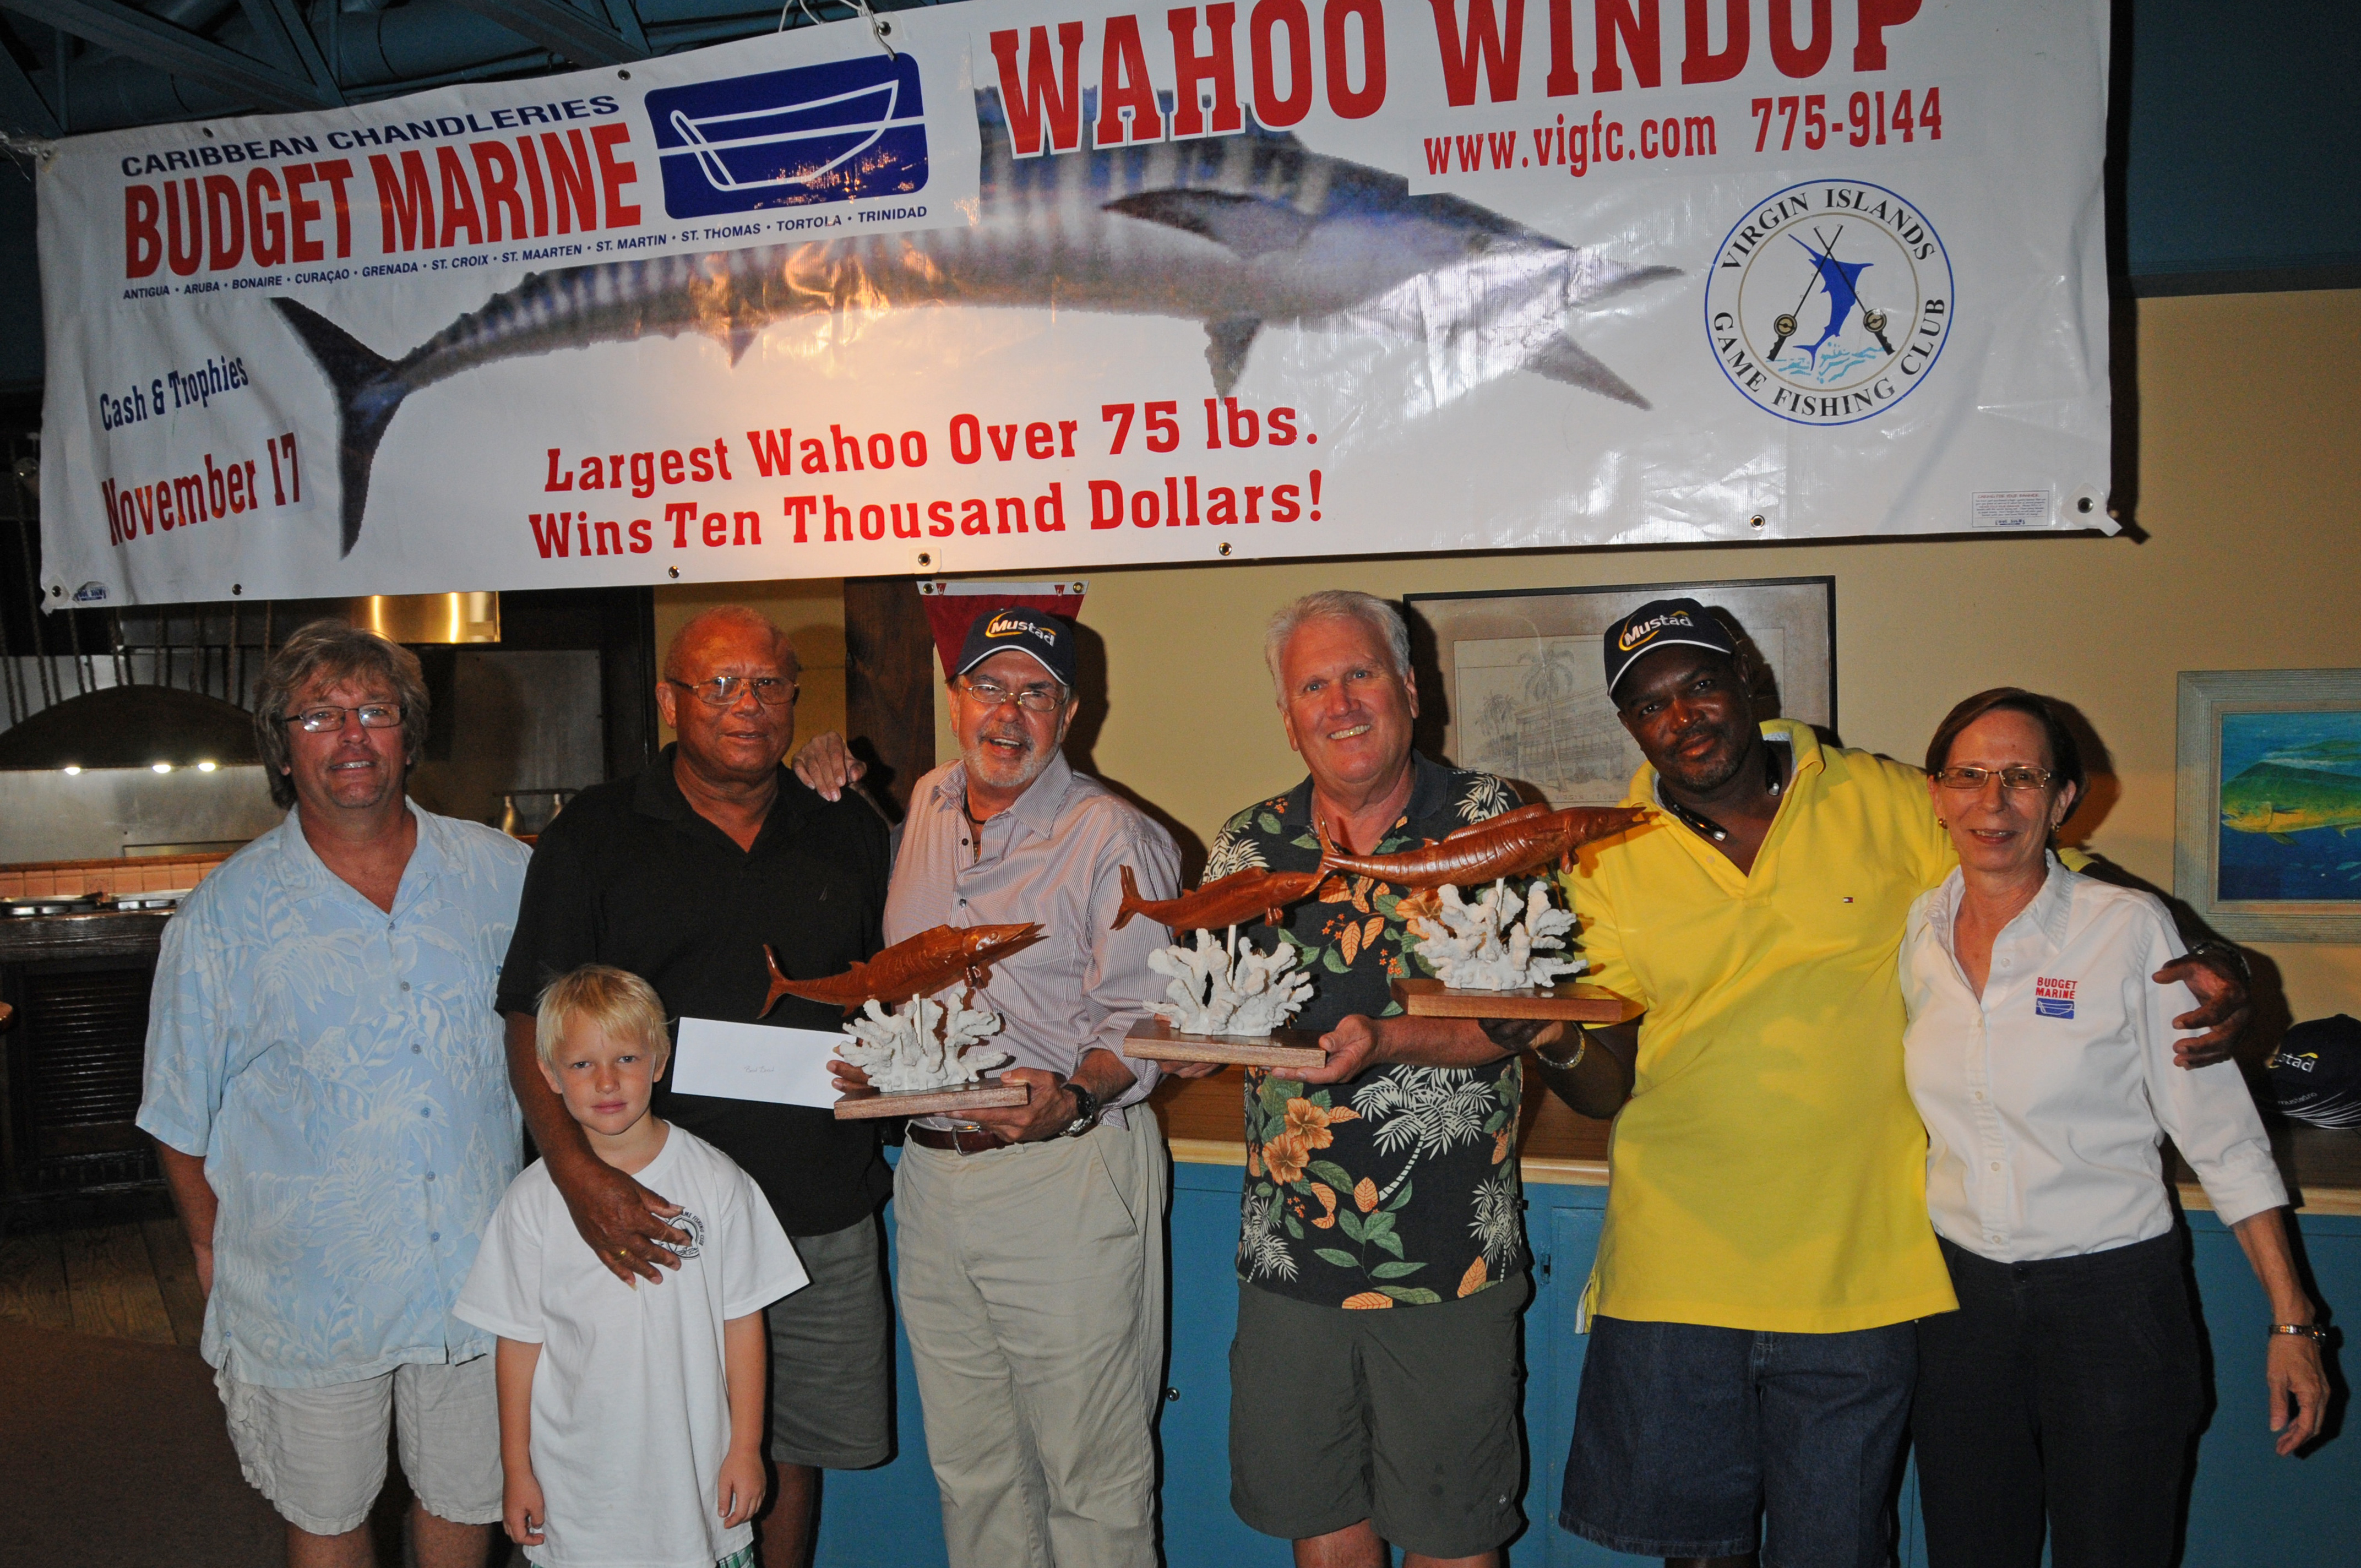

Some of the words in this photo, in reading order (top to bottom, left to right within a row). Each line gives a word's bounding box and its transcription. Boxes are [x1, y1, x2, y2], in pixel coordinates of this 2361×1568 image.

[989, 0, 1386, 154] WAHOO
[1429, 0, 1922, 107] WINDUP
[122, 137, 318, 176] CARIBBEAN
[328, 96, 619, 149] CHANDLERIES
[1424, 110, 1717, 177] www.vigfc.com
[1752, 88, 1941, 151] 775-9144
[127, 159, 352, 277] BUDGET
[369, 123, 641, 253] MARINE
[1721, 192, 1809, 269] VIRGIN
[1825, 188, 1936, 260] ISLANDS
[123, 286, 170, 299] ANTIGUA
[184, 282, 219, 294] ARUBA
[232, 276, 281, 289] BONAIRE
[296, 269, 349, 284] CURAÇAO
[362, 263, 418, 276] GRENADA
[432, 259, 446, 270] ST.
[452, 255, 488, 268] CROIX
[502, 252, 516, 262] ST.
[523, 245, 581, 260] MAARTEN
[597, 241, 611, 252] ST.
[618, 235, 666, 249] MARTIN
[682, 231, 697, 241] ST.
[704, 224, 760, 238] THOMAS
[777, 215, 841, 231] TORTOLA
[858, 207, 927, 222] TRINIDAD
[100, 386, 148, 431] Cash
[152, 379, 165, 415] &
[168, 356, 248, 408] Trophies
[1714, 312, 1767, 392] GAME
[1771, 377, 1895, 417] FISHING
[1901, 299, 1945, 375] CLUB
[101, 453, 258, 546] November
[266, 432, 301, 507] 17
[545, 437, 732, 499] Largest
[746, 423, 928, 478] Wahoo
[949, 413, 1078, 465] Over
[1101, 401, 1180, 455] 75
[1204, 397, 1318, 449] lbs.
[529, 511, 653, 558] Wins
[665, 502, 762, 548] Ten
[783, 482, 1066, 544] Thousand
[1089, 469, 1322, 530] Dollars!
[991, 619, 1055, 647] Mustad
[1624, 614, 1694, 646] Mustad
[2035, 987, 2075, 999] MARINE
[2037, 977, 2077, 989] BUDGET
[692, 1216, 705, 1233] FISHING
